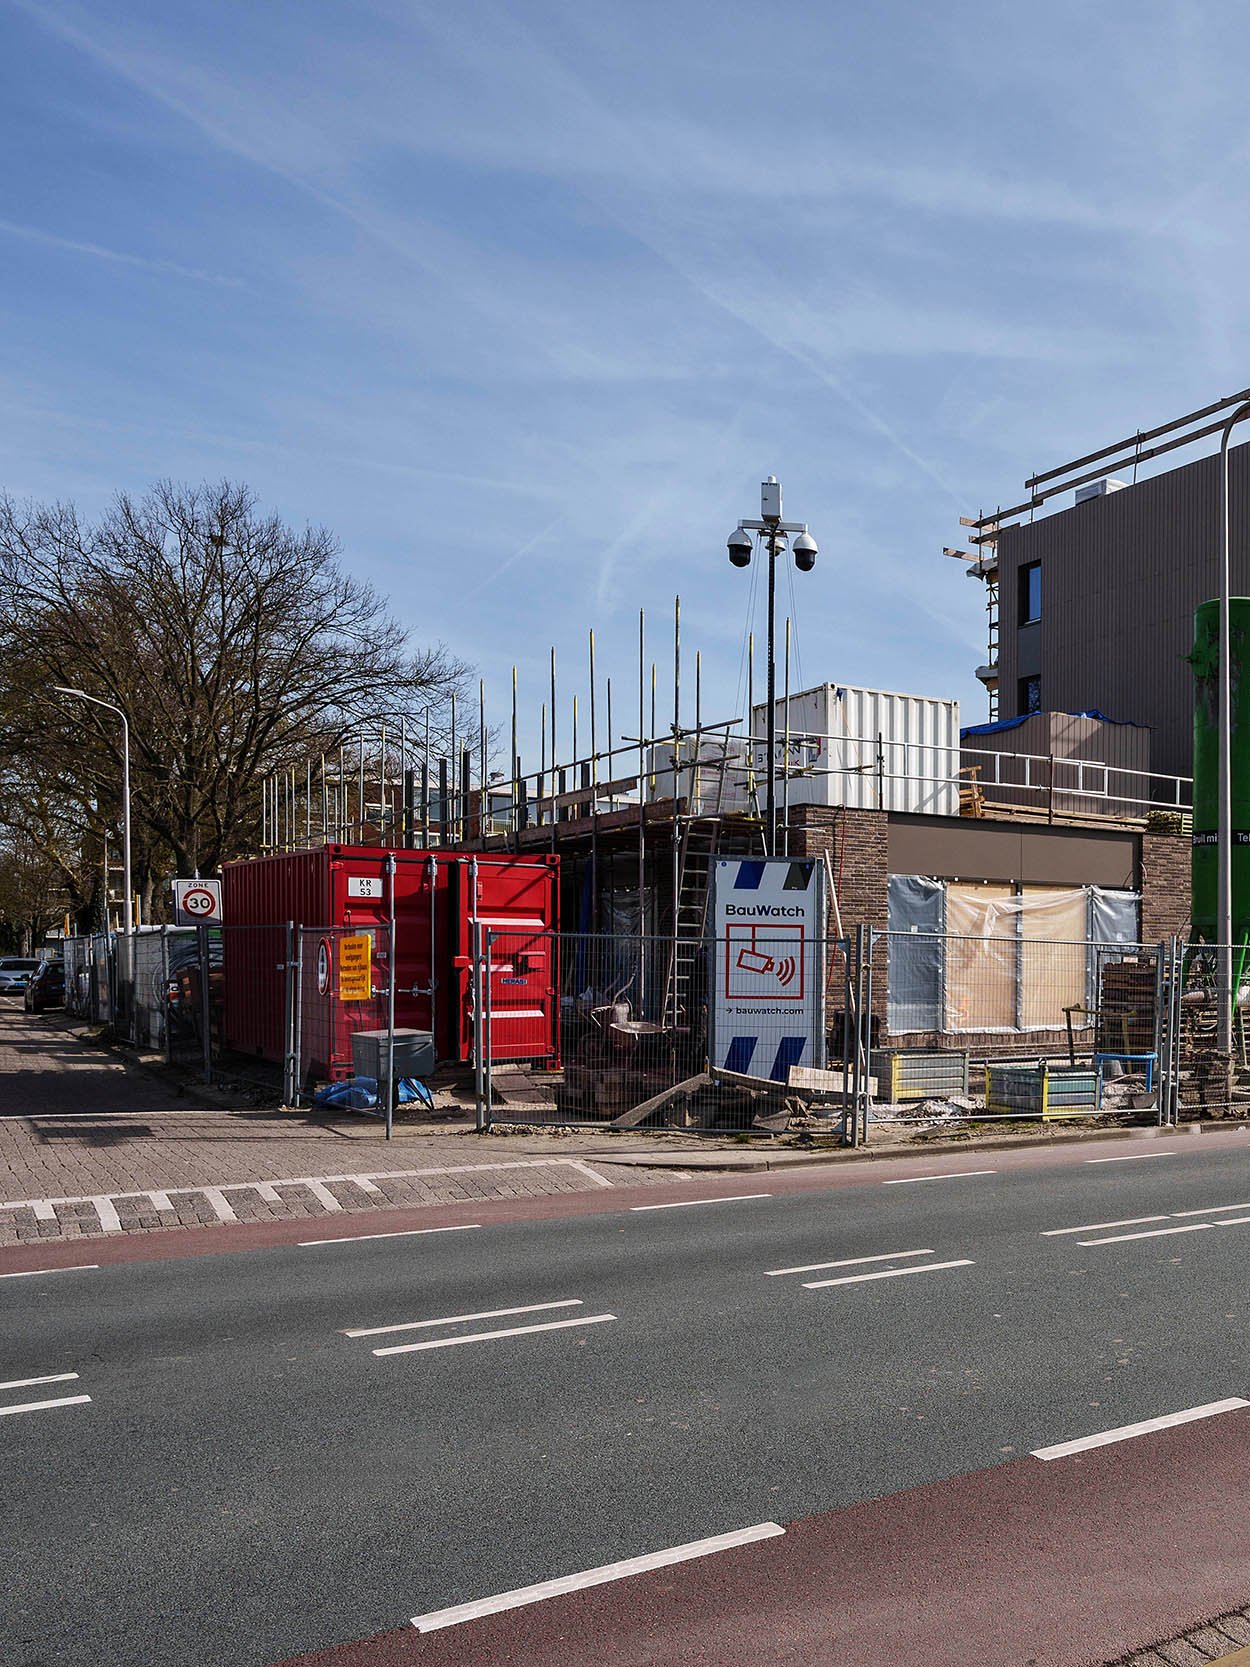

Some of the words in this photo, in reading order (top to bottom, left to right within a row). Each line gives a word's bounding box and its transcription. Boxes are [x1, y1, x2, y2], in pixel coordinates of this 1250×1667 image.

[360, 879, 372, 887] KR
[360, 888, 372, 896] 53
[189, 897, 210, 909] 30
[725, 904, 805, 917] BauWatch
[736, 1007, 804, 1015] bauwatch.com
